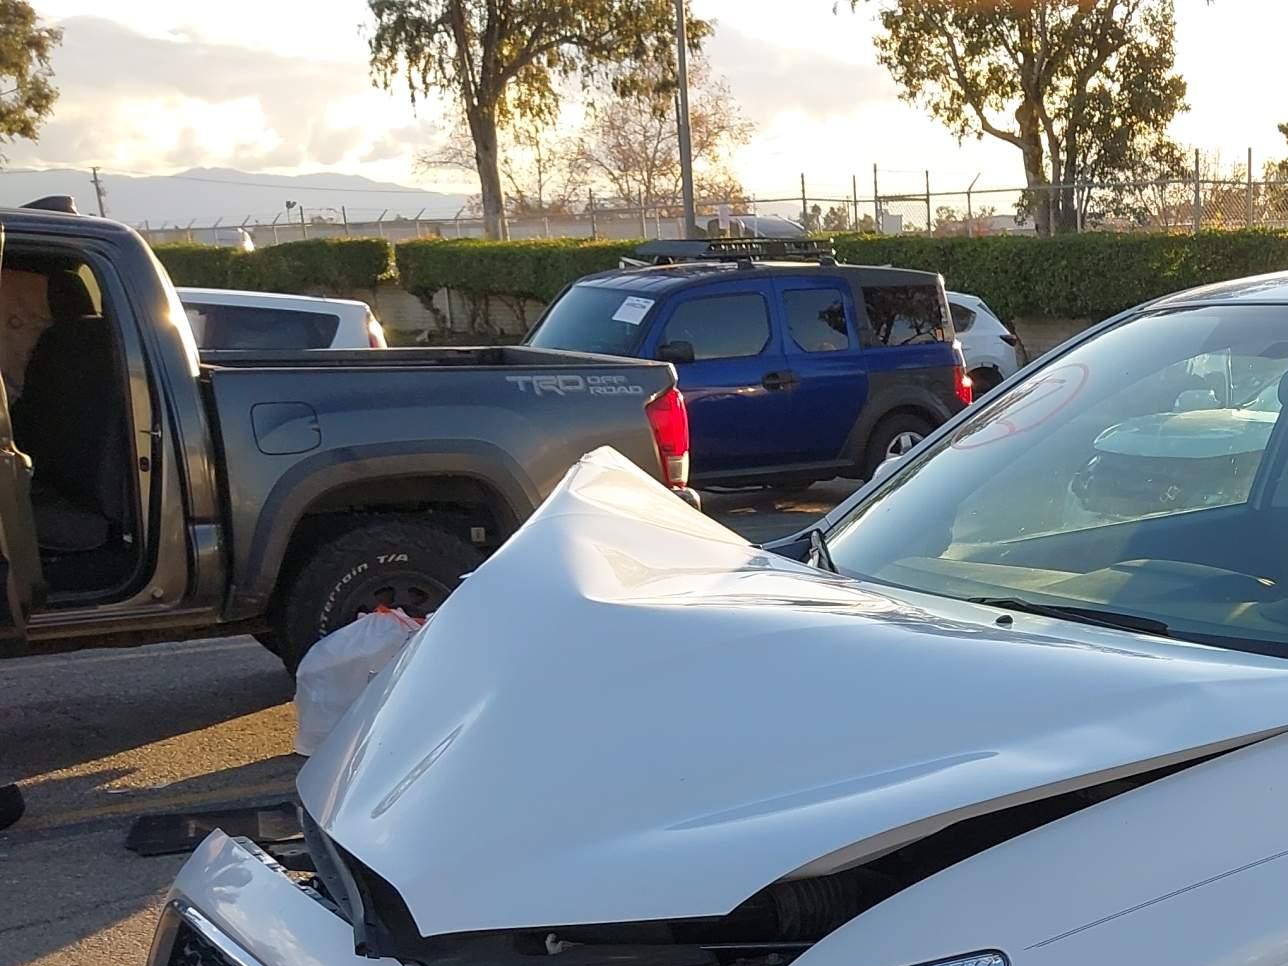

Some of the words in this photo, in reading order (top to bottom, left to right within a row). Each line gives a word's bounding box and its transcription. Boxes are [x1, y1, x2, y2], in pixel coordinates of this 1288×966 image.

[505, 375, 585, 397] TRD
[587, 375, 628, 384] OFF
[589, 385, 644, 396] ROAD
[376, 552, 409, 565] T/A
